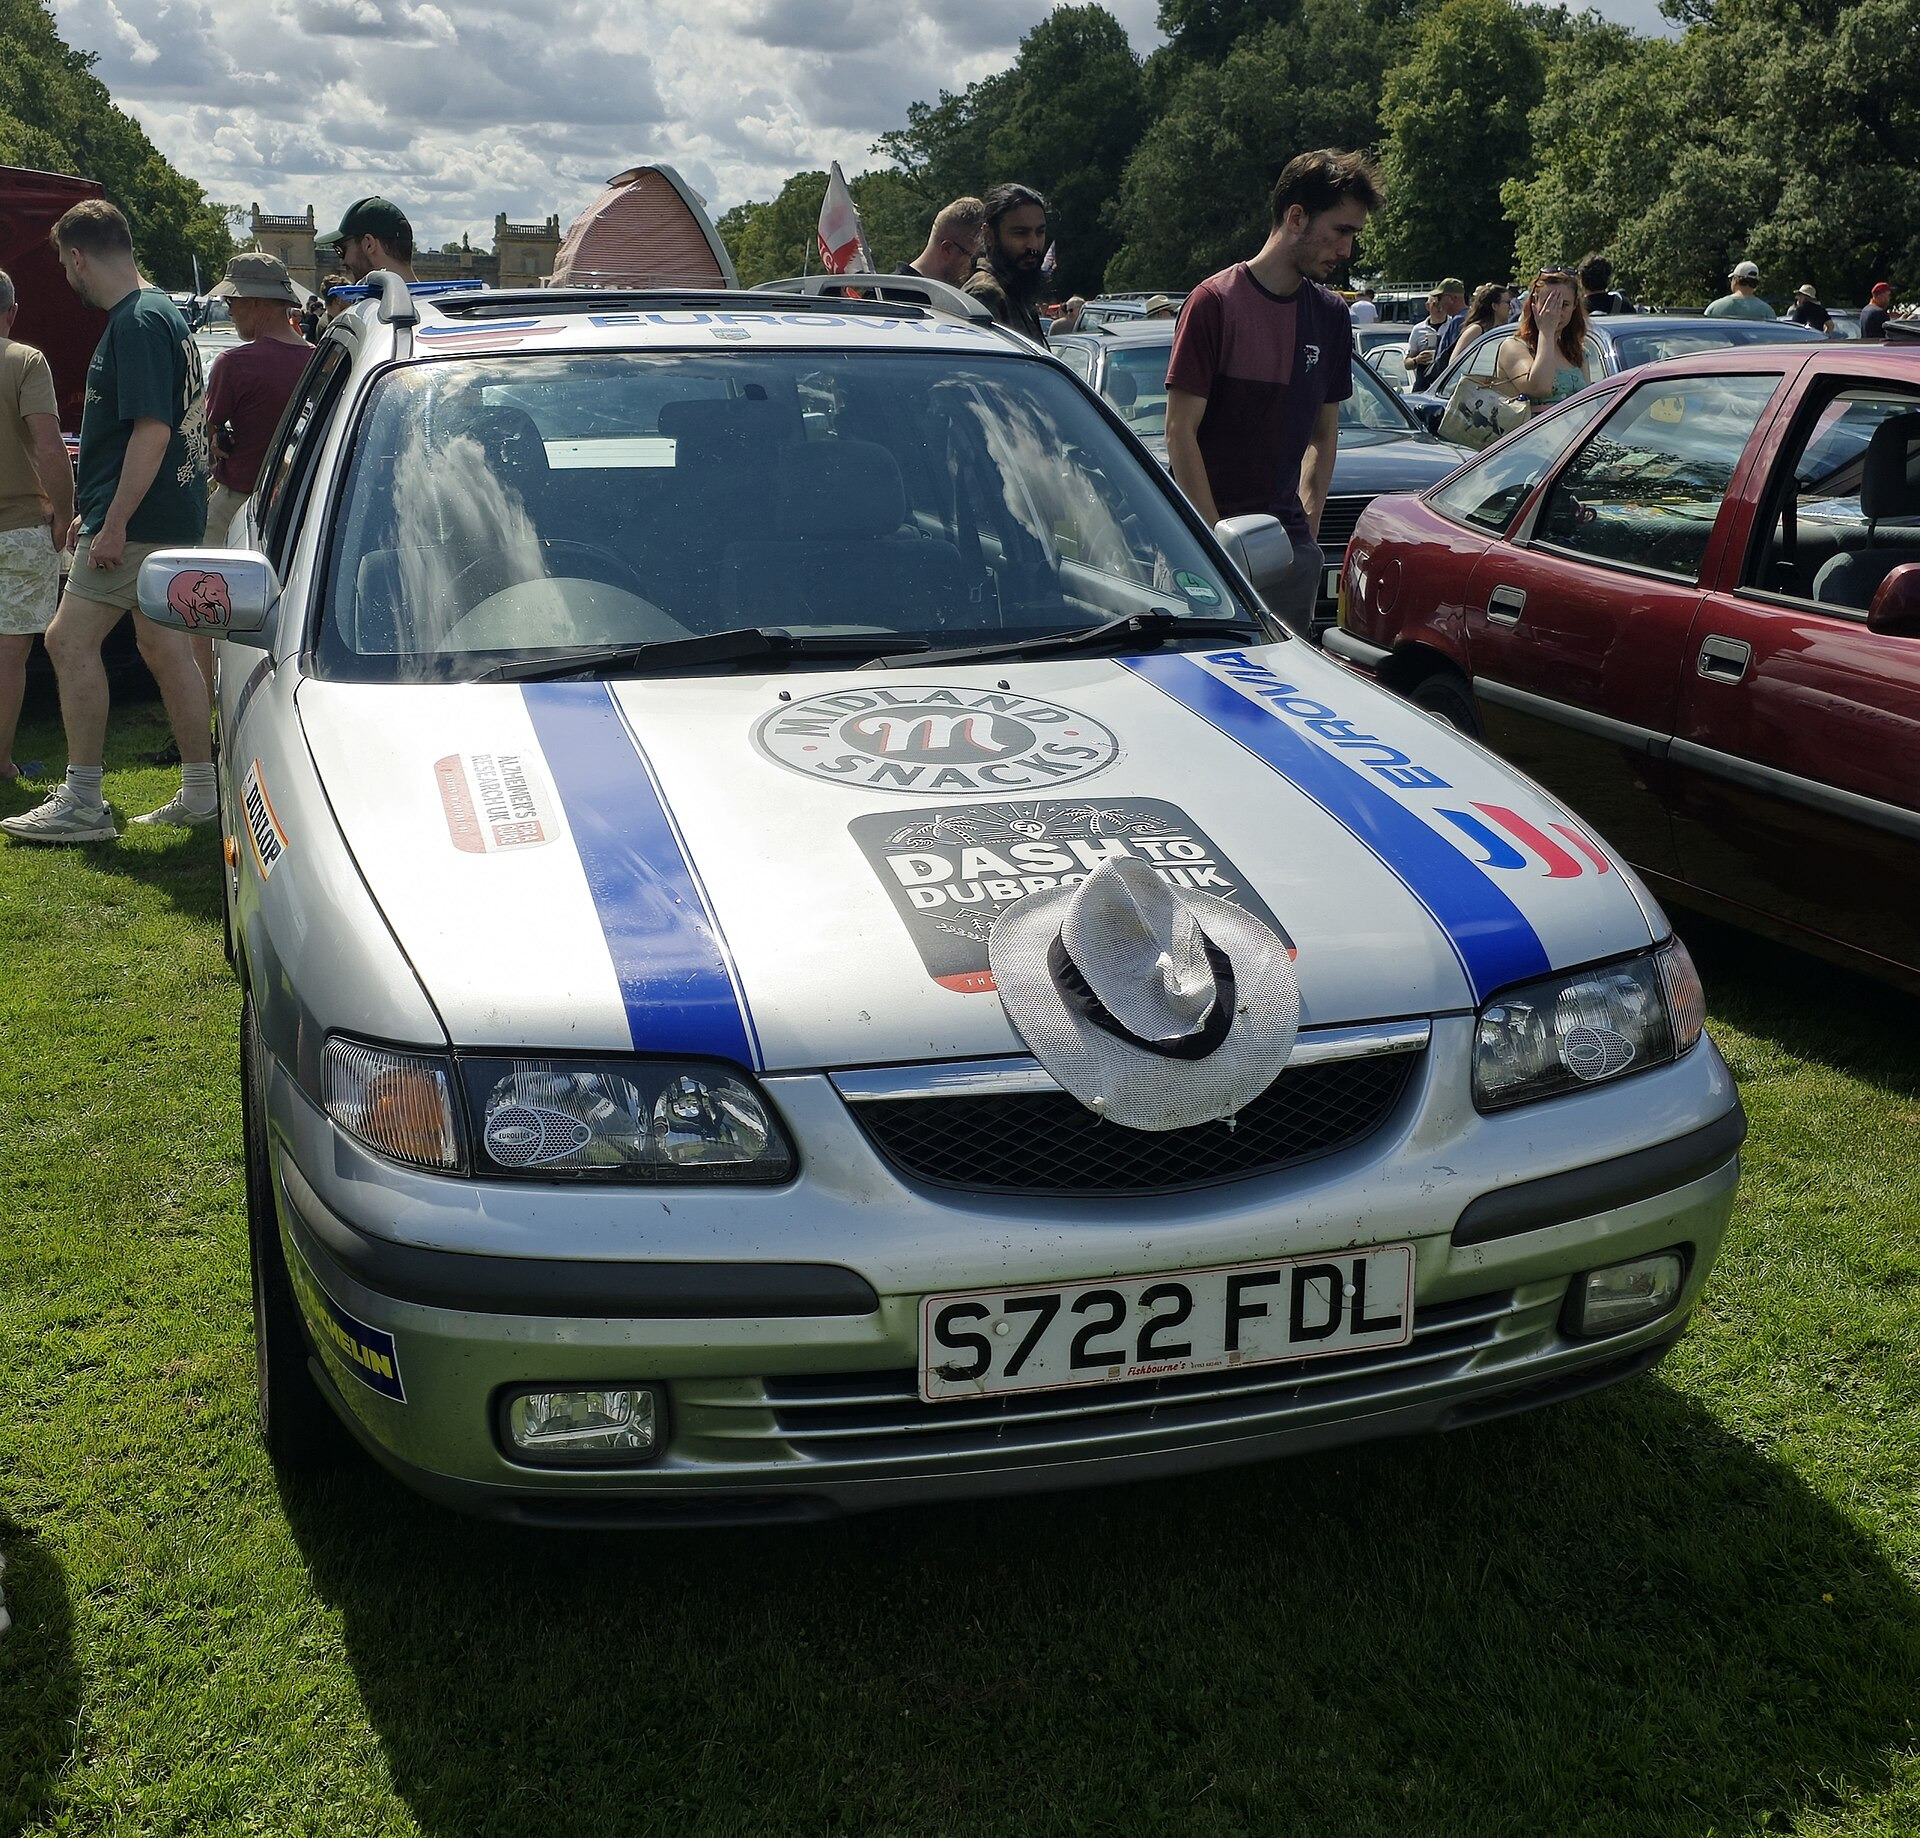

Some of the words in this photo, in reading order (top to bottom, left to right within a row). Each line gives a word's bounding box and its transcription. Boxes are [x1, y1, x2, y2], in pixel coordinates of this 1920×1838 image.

[587, 312, 994, 339] EUROVIA
[774, 689, 1070, 738] MIDLAND
[1204, 651, 1454, 789] EUROVIA
[471, 754, 505, 805] RESEARCH
[497, 755, 537, 819] ALZHEIMER'S
[815, 742, 1099, 789] SNACKS
[246, 782, 282, 867] DUNLOP
[486, 806, 511, 822] UK
[885, 838, 1133, 887] DASH
[1132, 841, 1206, 860] TO
[905, 866, 1234, 910] DUBRIK
[933, 1282, 1194, 1382] S722
[1223, 1258, 1402, 1351] FDL
[1127, 1361, 1187, 1376] Fishbourne's
